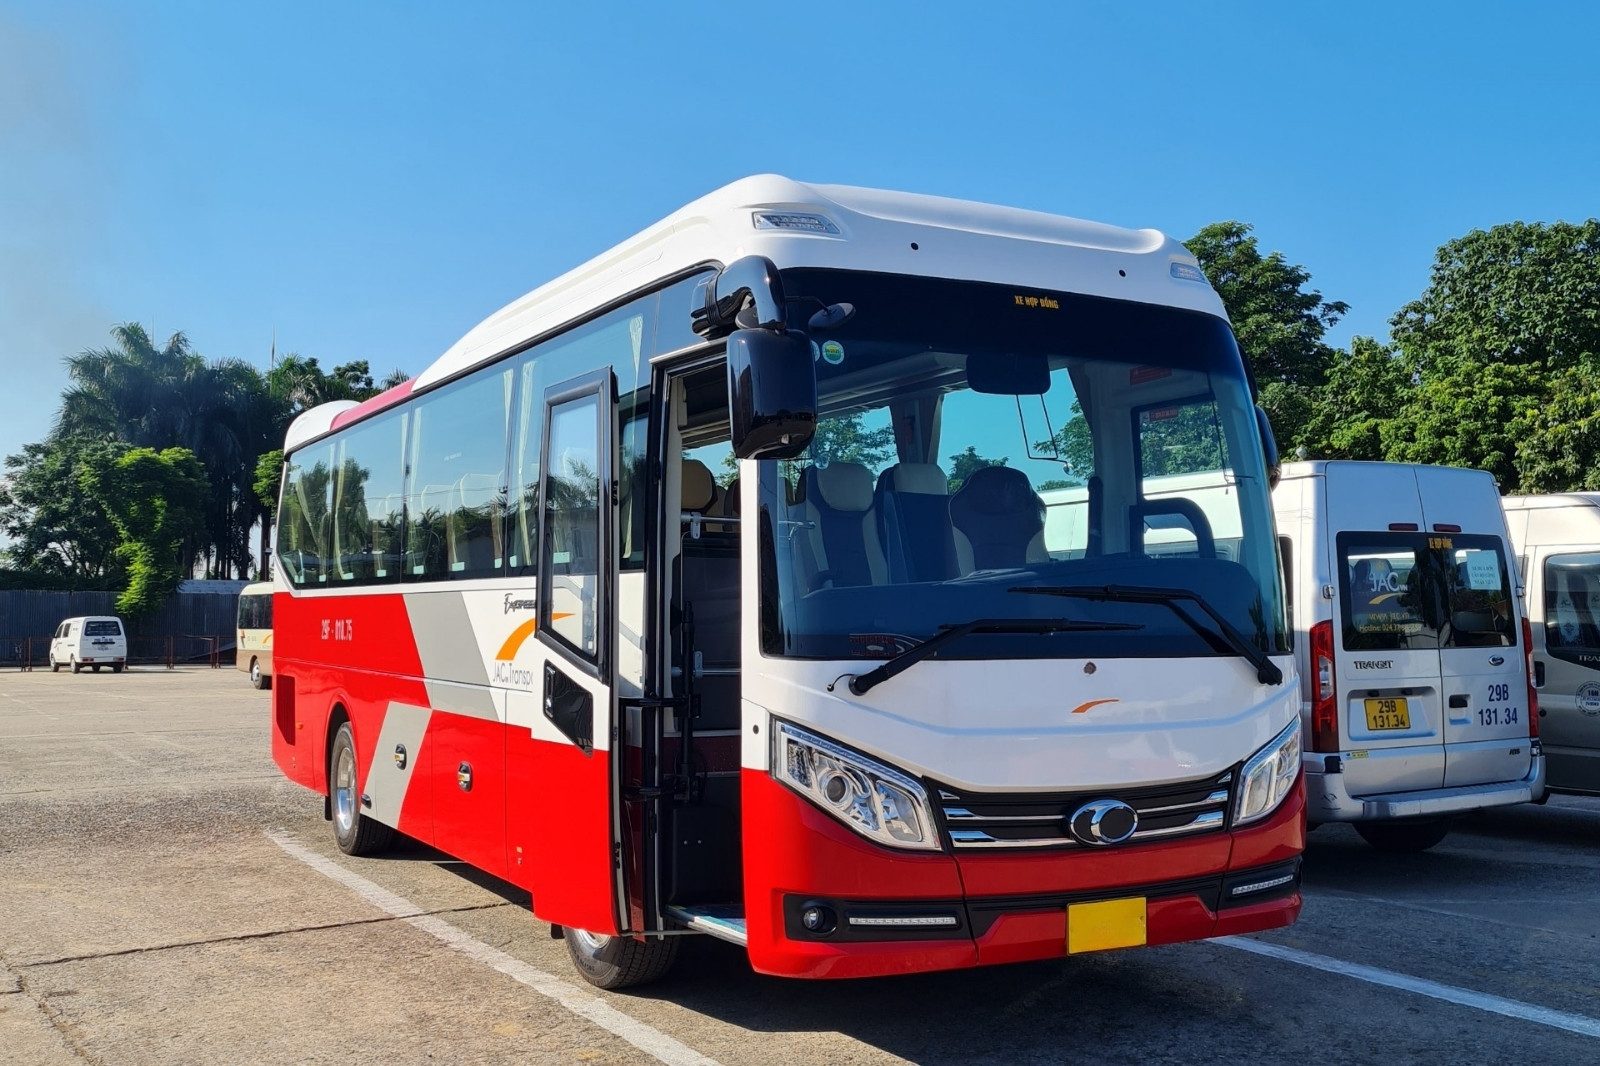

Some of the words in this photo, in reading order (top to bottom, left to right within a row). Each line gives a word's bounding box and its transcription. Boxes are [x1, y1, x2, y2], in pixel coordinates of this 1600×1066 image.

[1014, 295, 1024, 305] XE
[1354, 660, 1393, 670] TRANSIT
[1487, 683, 1509, 702] 29B
[1378, 700, 1397, 713] 29B
[1373, 714, 1406, 728] 131.34
[1478, 707, 1518, 726] 131.34
